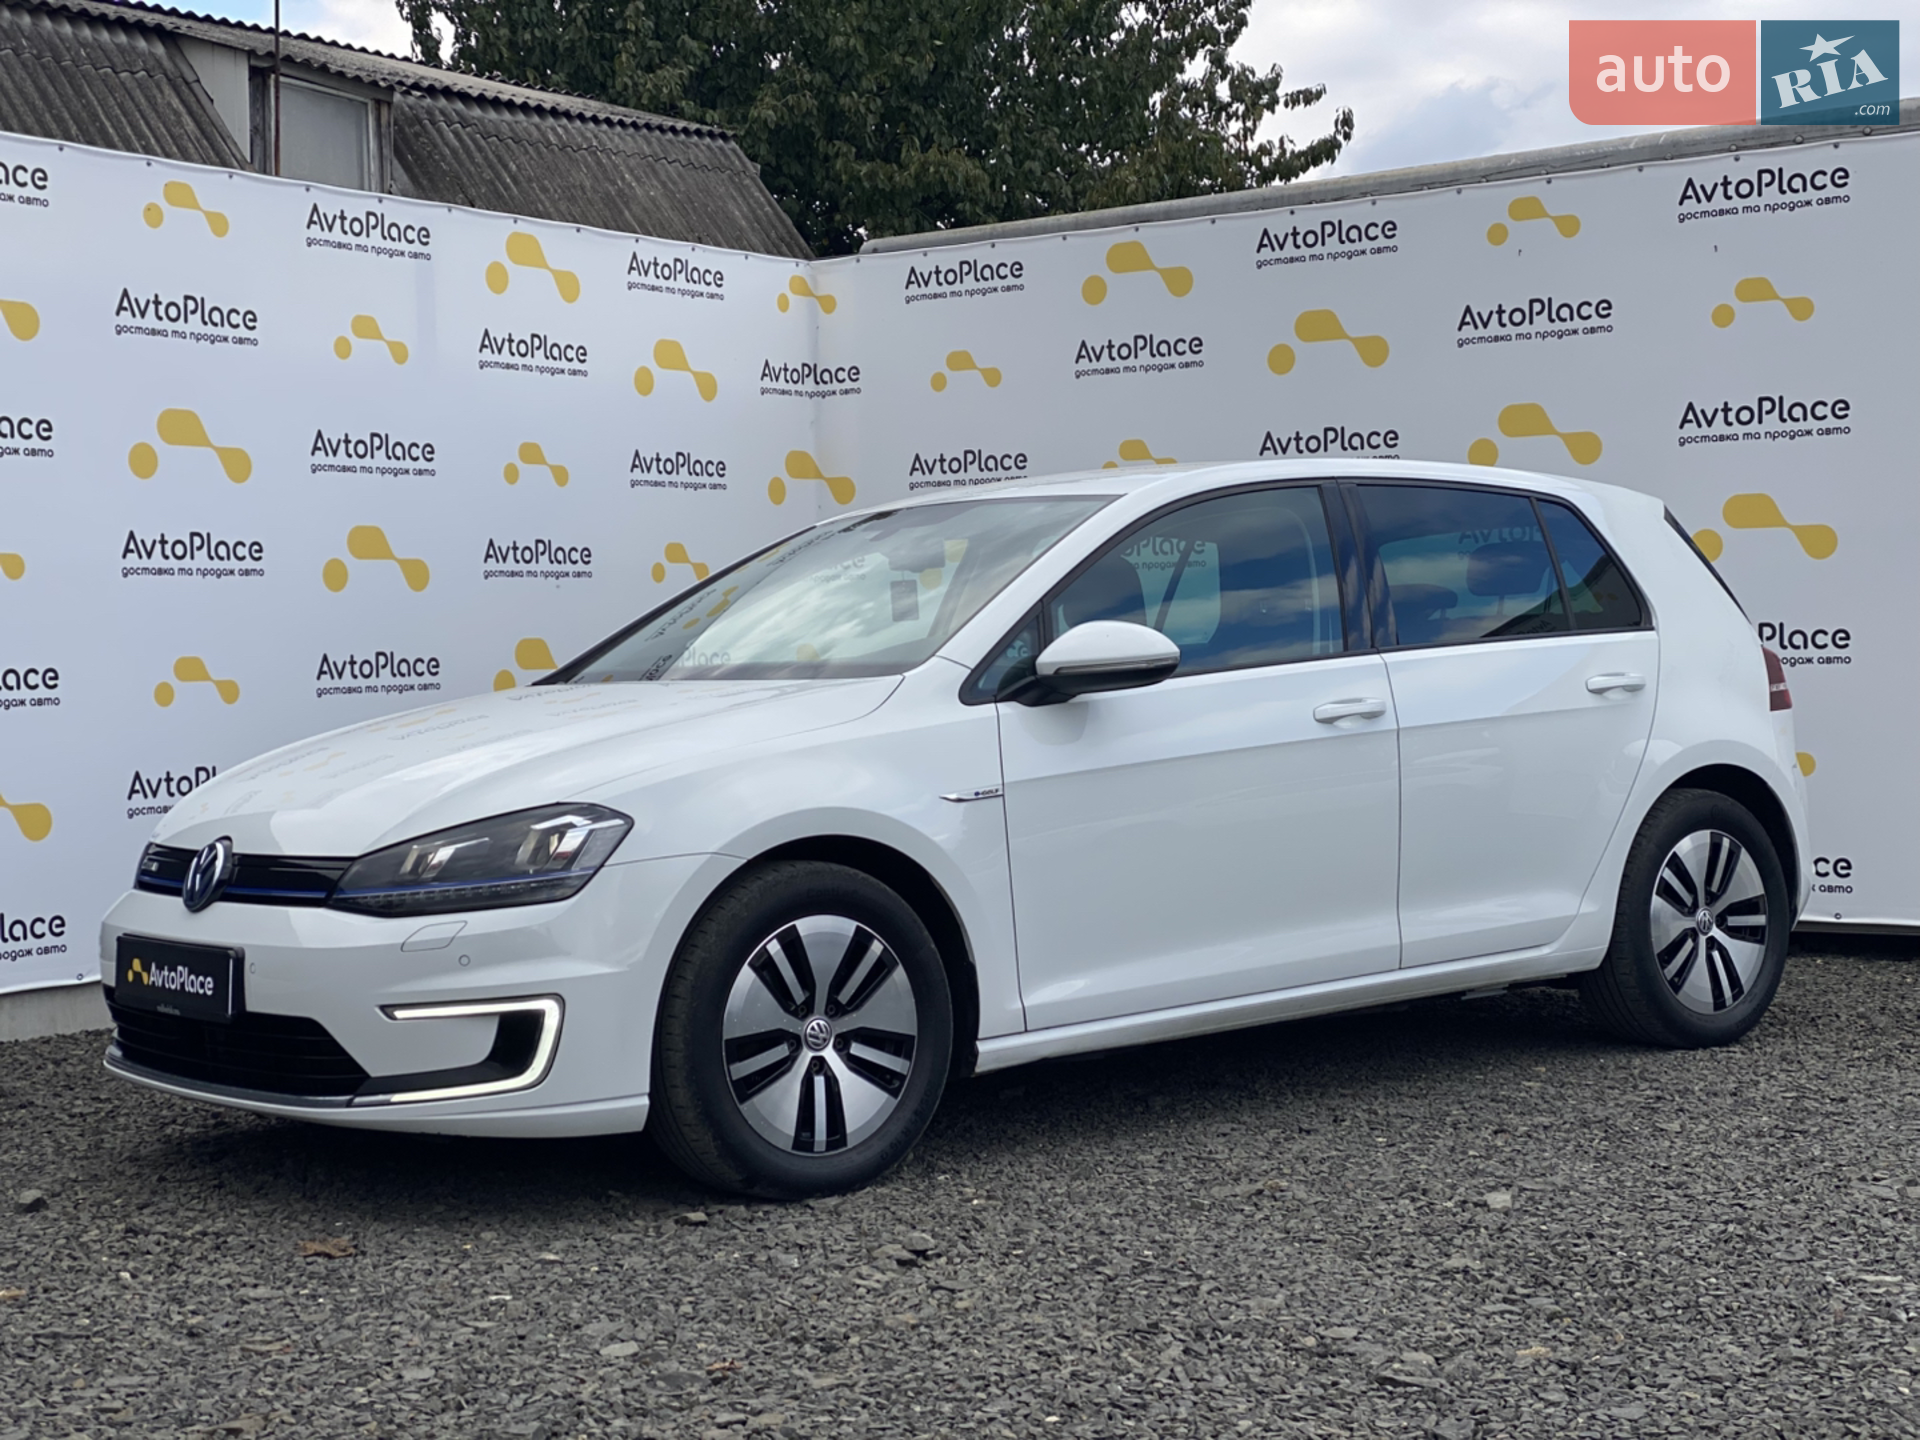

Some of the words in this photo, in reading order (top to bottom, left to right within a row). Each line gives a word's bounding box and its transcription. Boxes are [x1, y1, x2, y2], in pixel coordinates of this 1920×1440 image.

[1678, 167, 1850, 206] AvtoPlace
[1678, 207, 1739, 223] доставка
[1742, 205, 1761, 214] та
[1764, 199, 1813, 214] продаж
[1816, 195, 1850, 206] авто
[306, 202, 431, 247] AvtoPlace
[1256, 219, 1397, 254] AvtoPlace
[306, 237, 353, 251] доставка
[355, 244, 369, 253] та
[371, 246, 406, 259] продаж
[407, 251, 431, 261] авто
[1256, 255, 1306, 270] доставка
[1309, 253, 1324, 261] та
[1327, 248, 1367, 261] продаж
[1369, 245, 1398, 255] авто
[627, 252, 724, 288] AvtoPlace
[905, 259, 1024, 290] AvtoPlace
[905, 292, 947, 304] доставка
[964, 286, 999, 298] продаж
[1000, 284, 1025, 292] авто
[115, 287, 258, 331] AvtoPlace
[1457, 297, 1613, 332] AvtoPlace
[115, 324, 169, 338] доставка
[171, 330, 187, 339] та
[189, 332, 229, 345] продаж
[231, 336, 259, 346] авто
[479, 328, 587, 364] AvtoPlace
[1075, 333, 1203, 364] AvtoPlace
[1457, 334, 1512, 348] доставка
[1515, 332, 1532, 341] та
[1535, 328, 1579, 341] продаж
[1582, 325, 1613, 335] авто
[760, 359, 860, 386] AvtoPlace
[1075, 367, 1121, 379] доставка
[1123, 365, 1137, 373] та
[1139, 363, 1176, 374] продаж
[1178, 360, 1204, 369] авто
[1679, 395, 1850, 430] AvtoPlace
[311, 429, 435, 463] AvtoPlace
[1259, 426, 1399, 456] AvtoPlace
[1678, 433, 1739, 447] доставка
[1742, 432, 1761, 440] та
[1764, 429, 1813, 441] продаж
[1816, 426, 1851, 436] авто
[23, 447, 54, 458] авто
[630, 449, 726, 478] AvtoPlace
[909, 449, 1028, 476] AvtoPlace
[310, 463, 357, 474] доставка
[359, 466, 373, 474] та
[375, 466, 410, 478] продаж
[412, 468, 436, 477] авто
[122, 530, 264, 562] AvtoPlace
[483, 538, 592, 565] AvtoPlace
[121, 567, 175, 578] доставка
[177, 567, 193, 576] та
[196, 568, 235, 579] продаж
[238, 568, 265, 577] авто
[316, 651, 440, 681] AvtoPlace
[1817, 656, 1852, 665] авто
[29, 697, 61, 707] авто
[316, 686, 363, 698] доставка
[365, 685, 379, 693] та
[381, 684, 415, 695] продаж
[417, 682, 441, 691] авто
[1818, 884, 1853, 894] авто
[36, 944, 68, 956] авто
[149, 961, 214, 996] AvtoPlace
